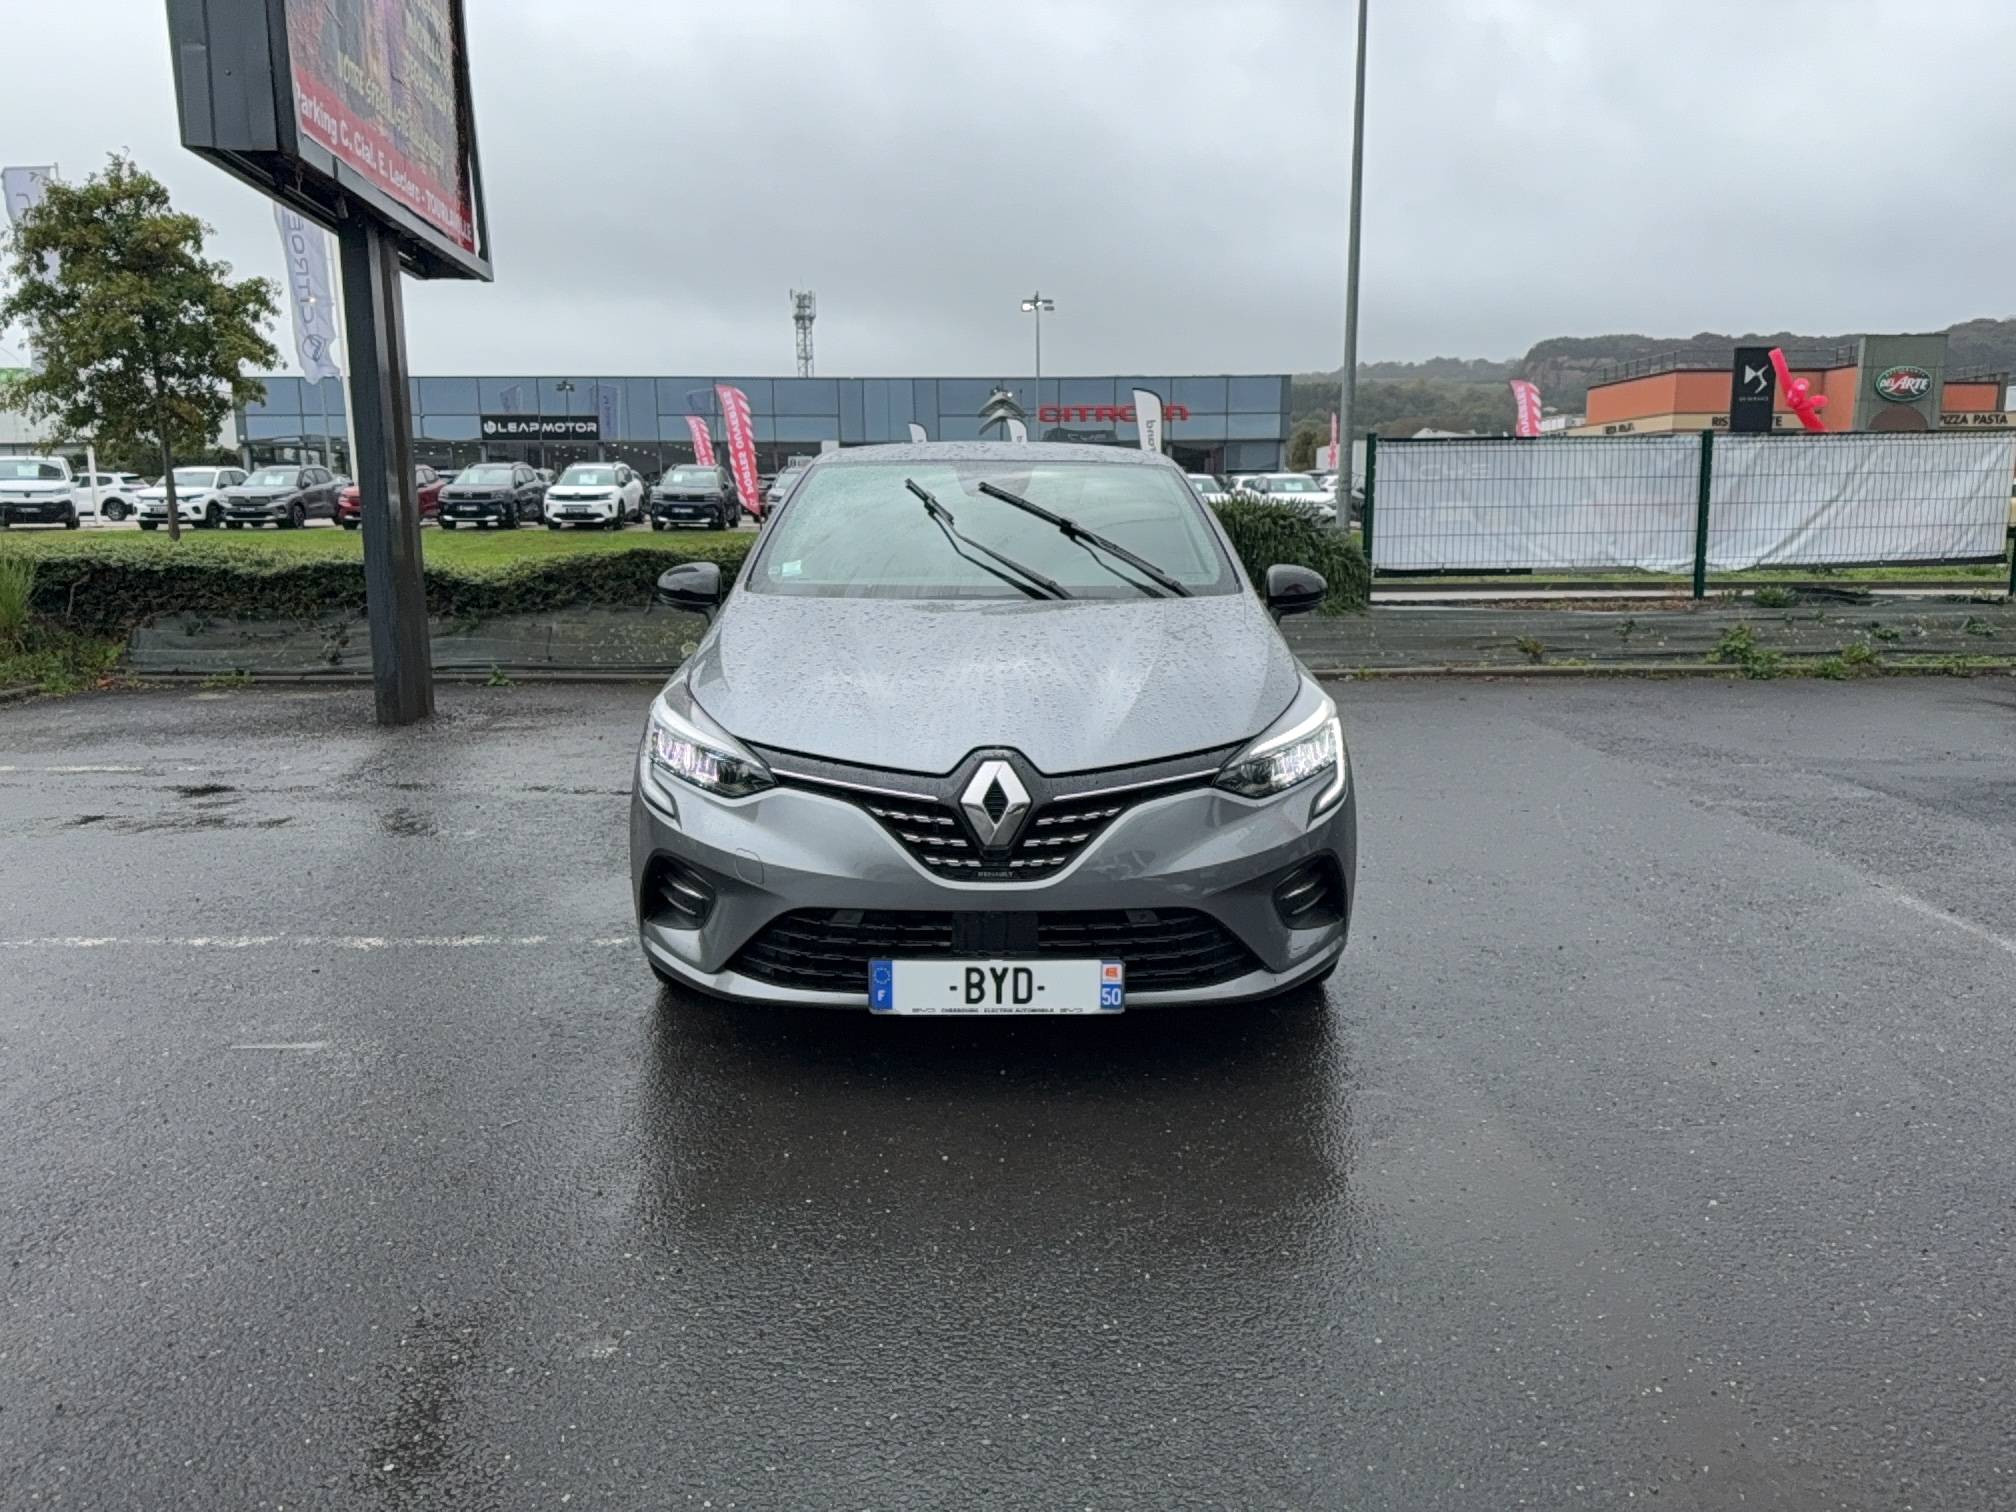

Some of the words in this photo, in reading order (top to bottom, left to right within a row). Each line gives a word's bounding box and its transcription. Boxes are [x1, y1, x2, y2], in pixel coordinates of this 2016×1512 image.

[1038, 405, 1189, 422] CITRON
[1941, 415, 1968, 425] PIZZA
[1974, 414, 2008, 424] PASTA
[877, 989, 885, 1001] F
[1102, 988, 1121, 1005] 50
